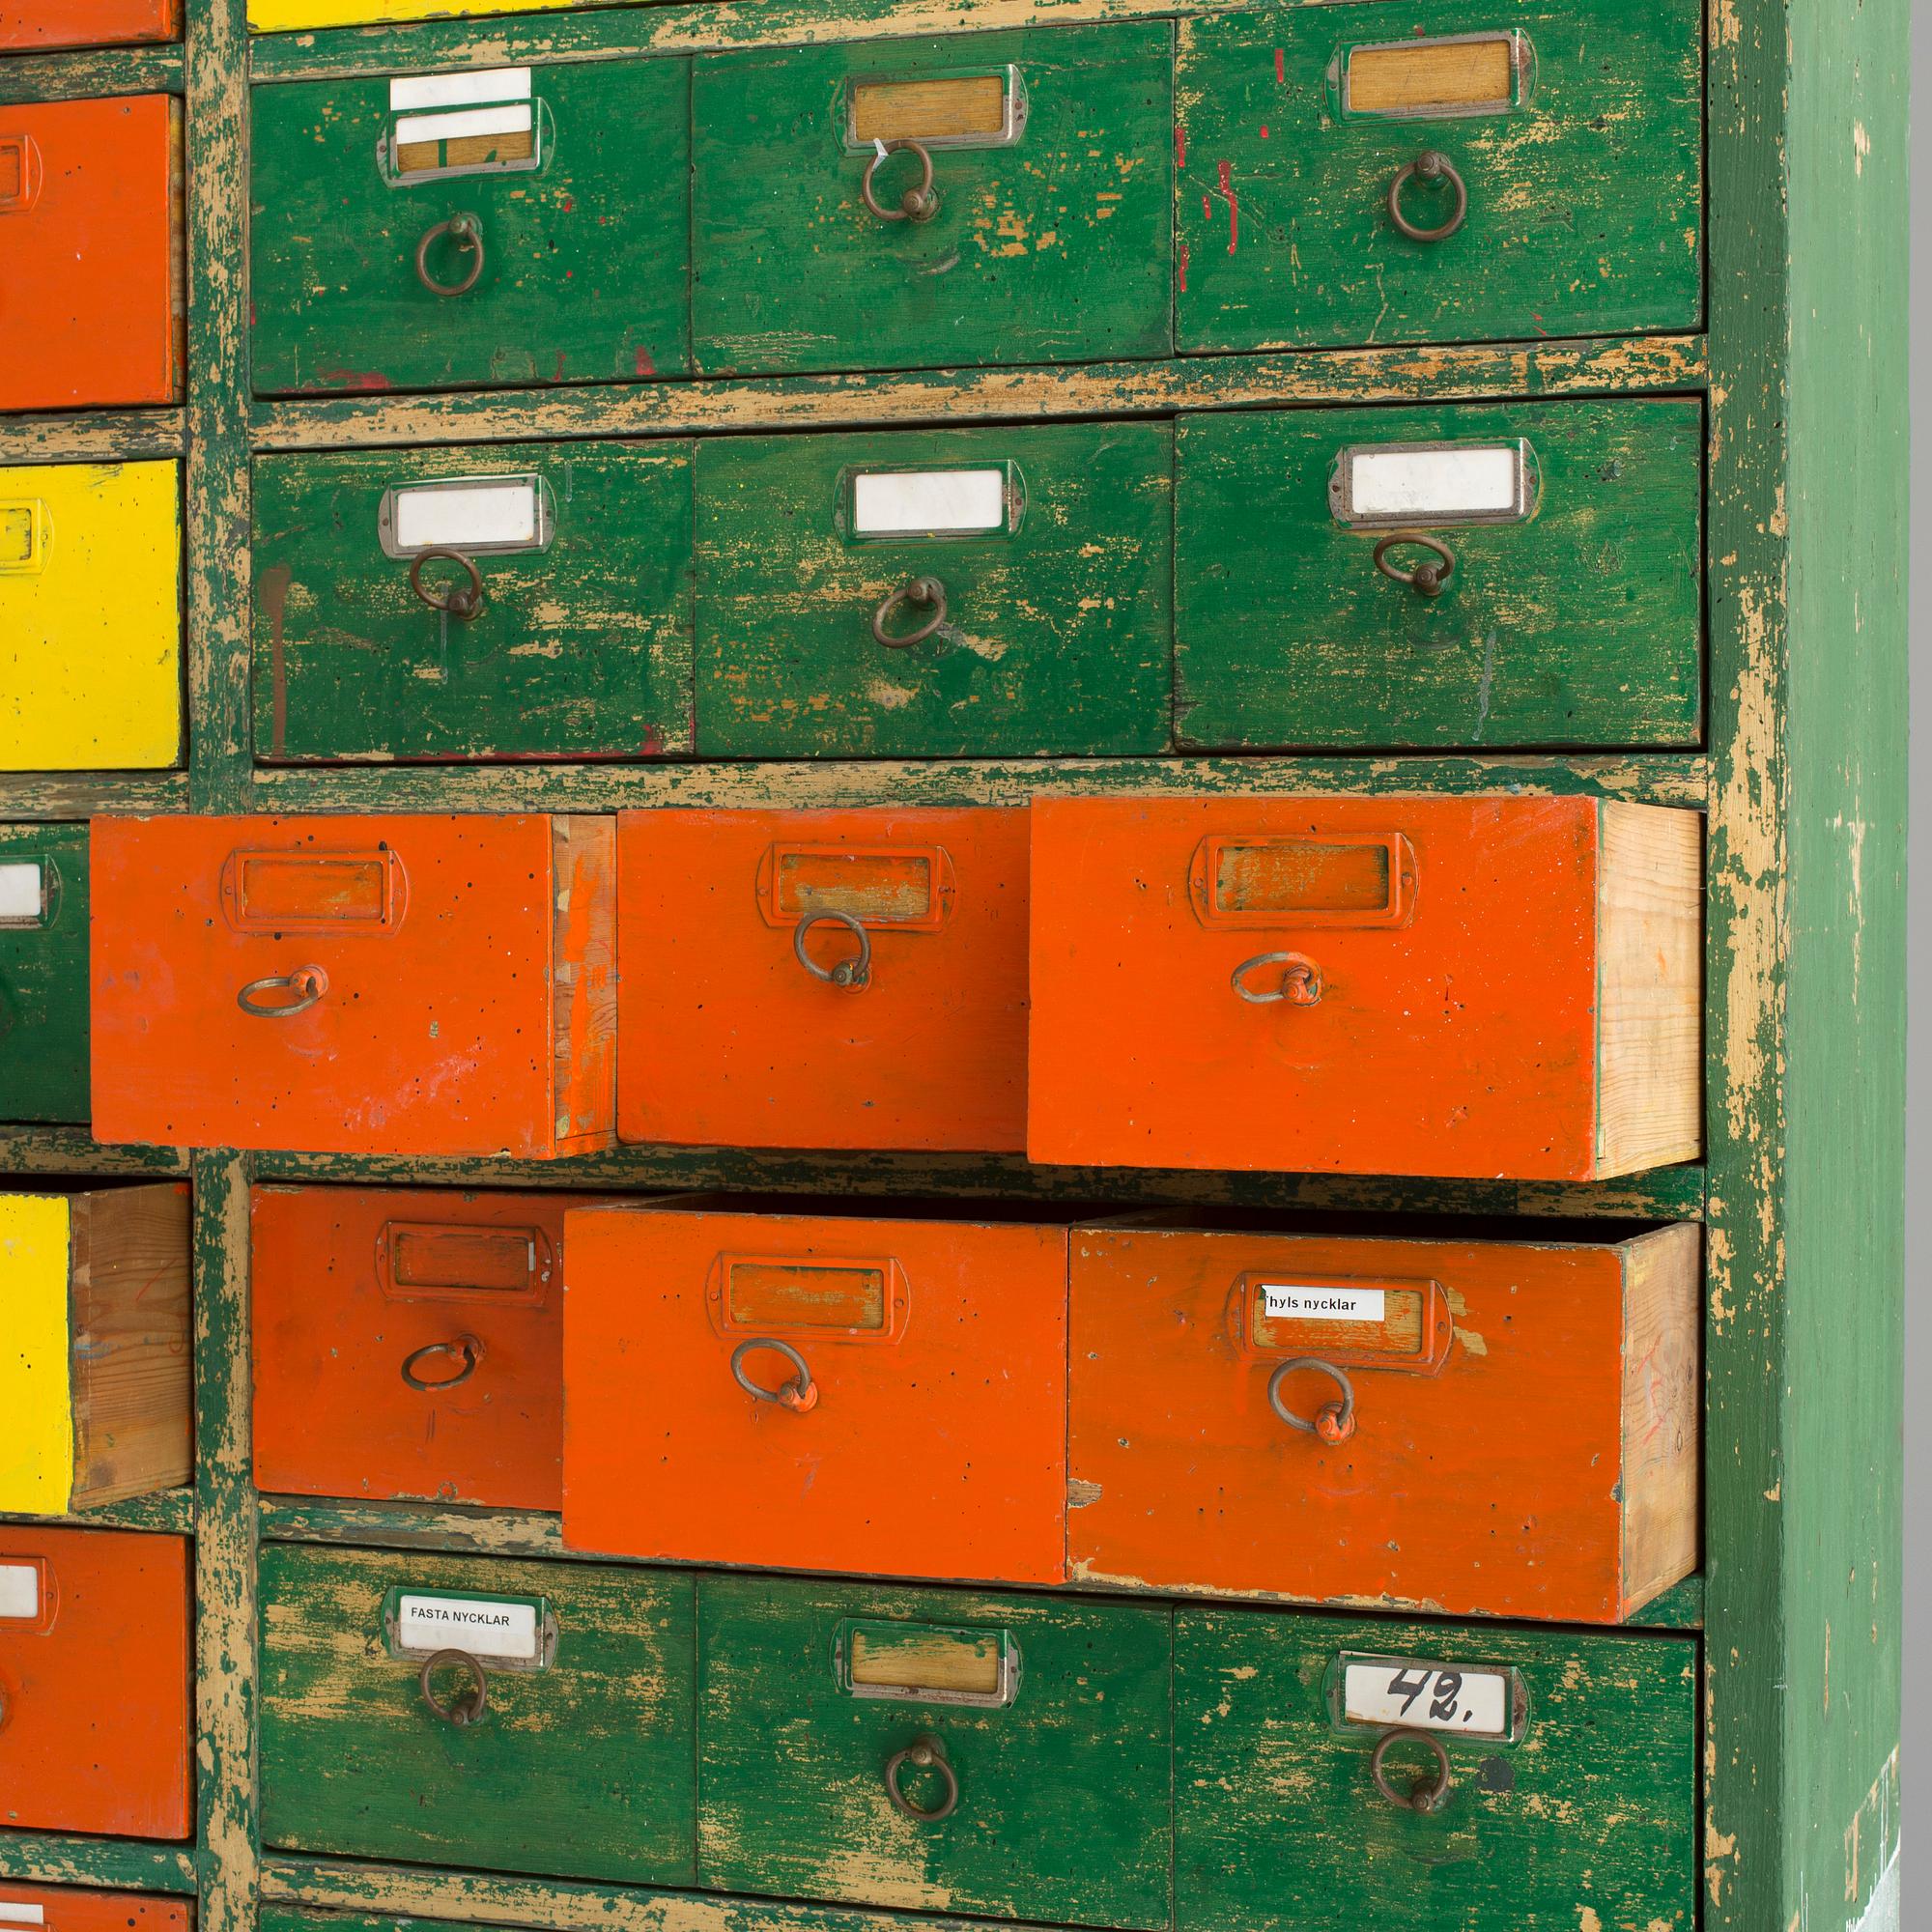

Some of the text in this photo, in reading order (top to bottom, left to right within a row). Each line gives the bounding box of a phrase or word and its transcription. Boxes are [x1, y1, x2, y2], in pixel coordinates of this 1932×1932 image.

[1304, 1297, 1357, 1311] nycklar
[411, 1606, 510, 1627] FASTA NYCKLAR
